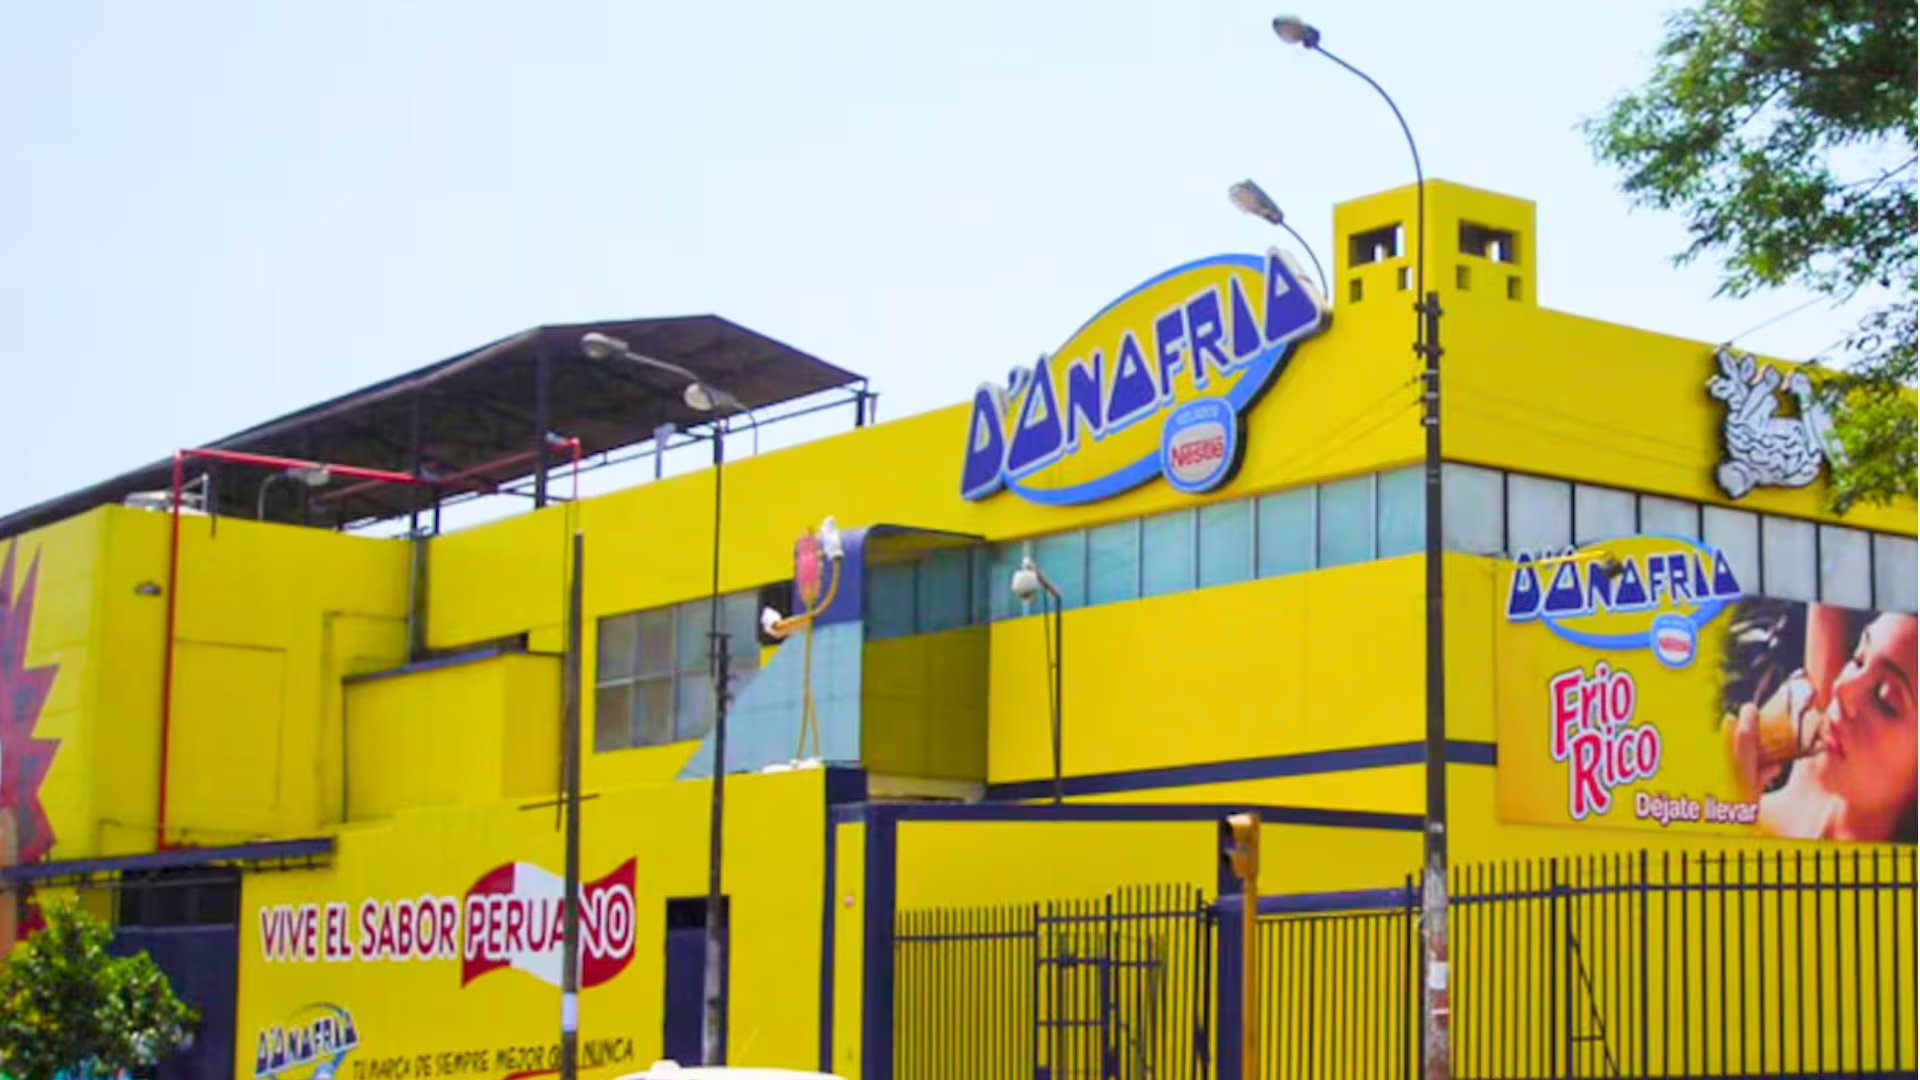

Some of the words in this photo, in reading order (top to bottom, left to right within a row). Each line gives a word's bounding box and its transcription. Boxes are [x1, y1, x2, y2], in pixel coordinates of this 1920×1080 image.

[1550, 661, 1634, 761] Frio
[1570, 723, 1661, 820] Rico
[1704, 794, 1758, 824] llevar
[260, 904, 318, 963] VIVE
[323, 901, 353, 962] EL
[358, 894, 457, 962] SABOR
[415, 1054, 433, 1078] DE
[497, 1045, 544, 1071] MEJOR
[582, 1037, 634, 1067] NUNCA
